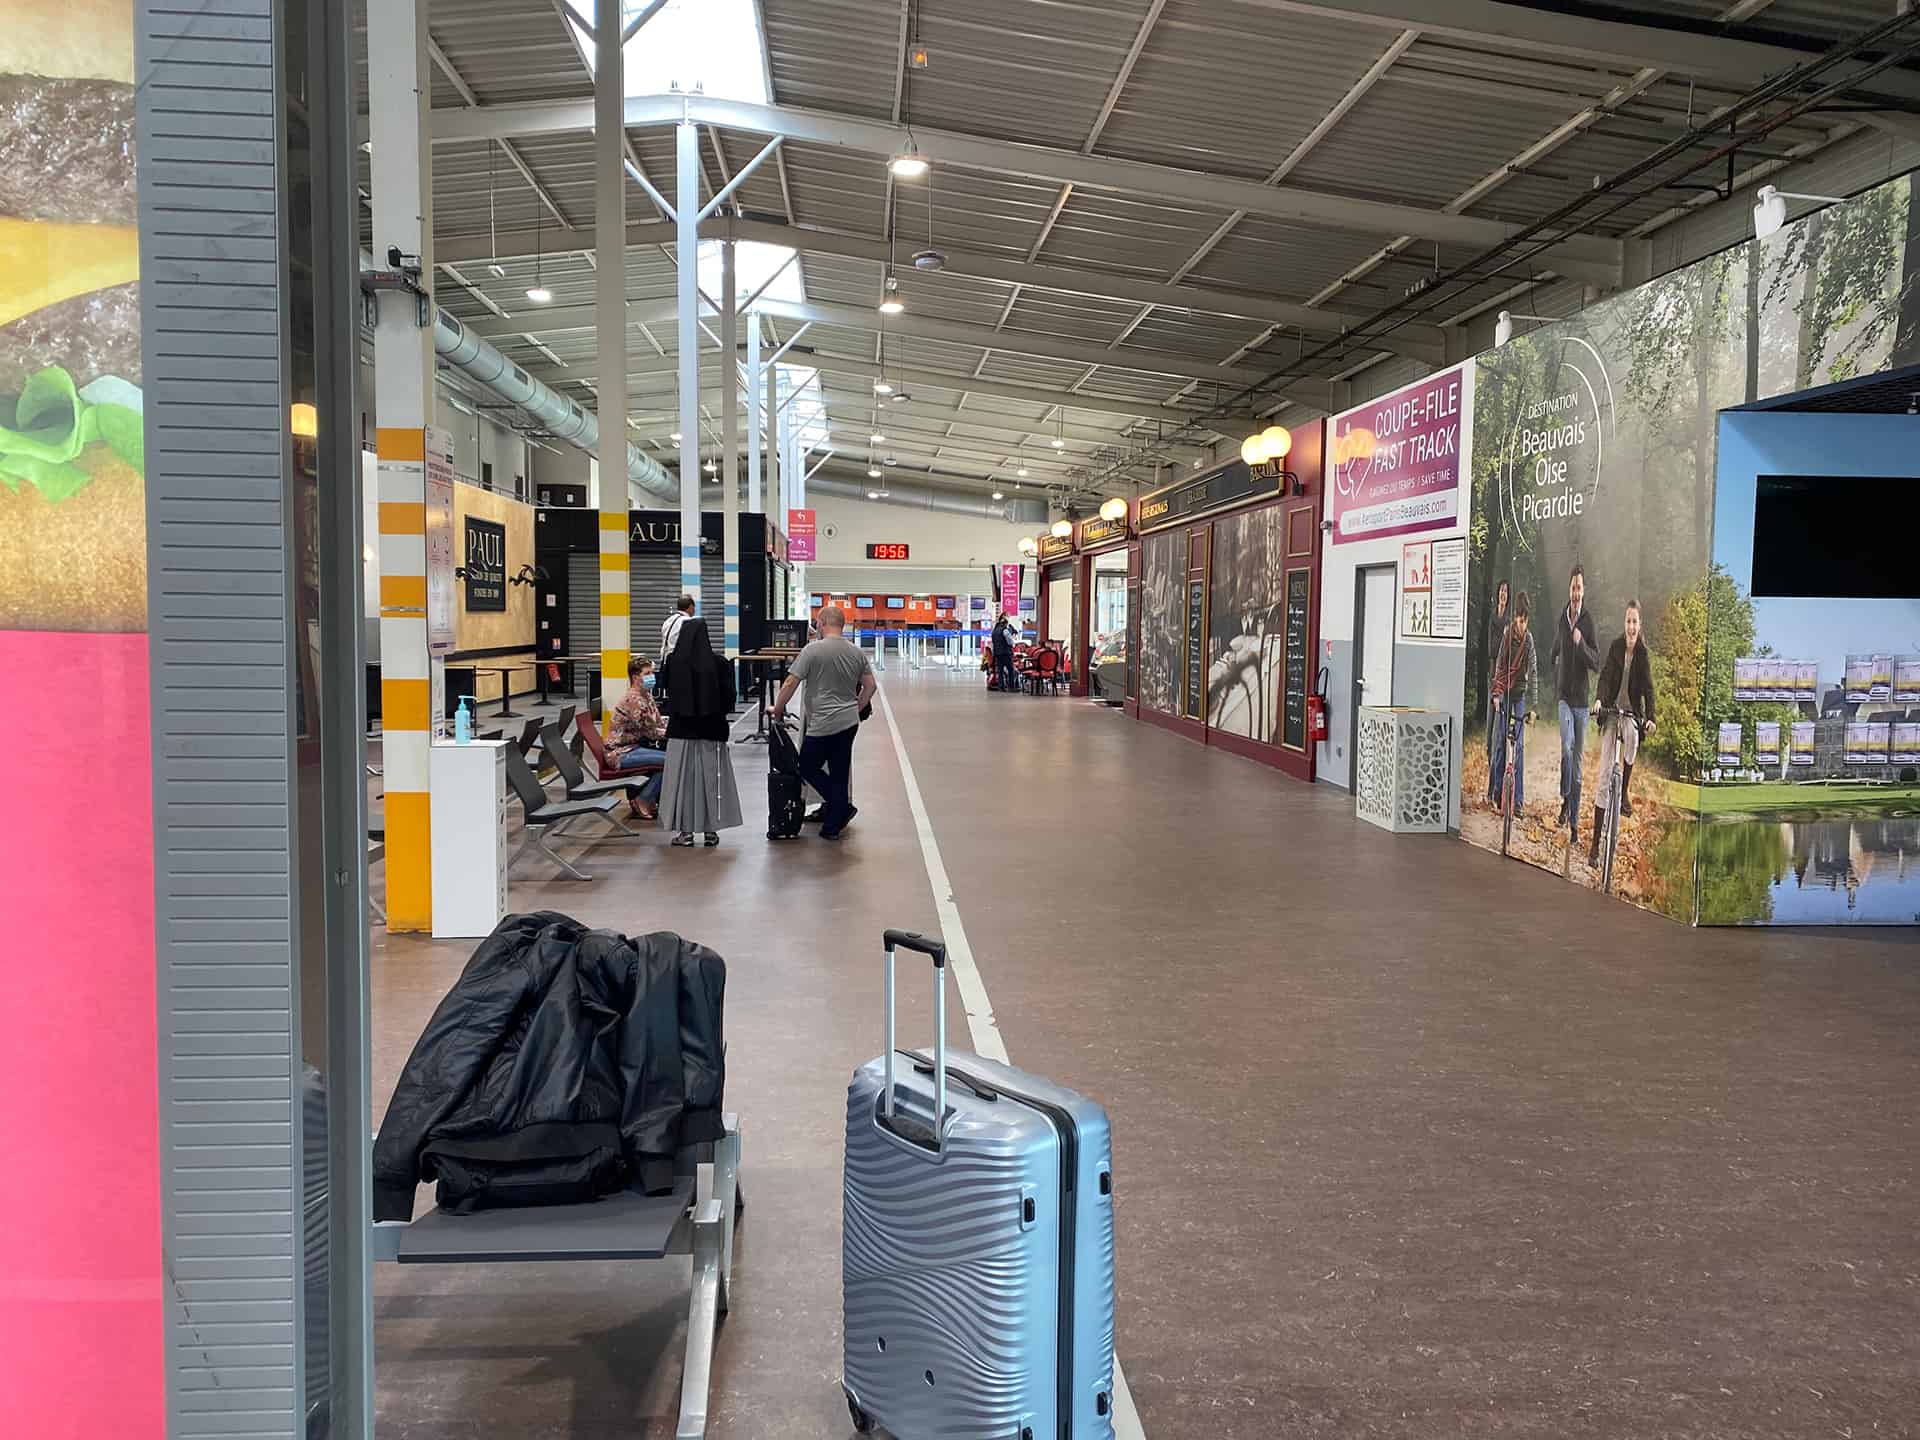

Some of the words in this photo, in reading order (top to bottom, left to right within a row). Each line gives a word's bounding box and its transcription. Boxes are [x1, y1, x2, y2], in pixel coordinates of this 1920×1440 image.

[1375, 382, 1458, 439] COUPE-FILE
[1528, 392, 1578, 419] DESTINATION
[1374, 440, 1406, 475] FAST
[1409, 423, 1457, 465] TRACK
[1522, 416, 1585, 457] Beauvais
[1535, 457, 1567, 486] Oise
[1522, 486, 1583, 521] Picardie
[468, 528, 503, 569] PAUL
